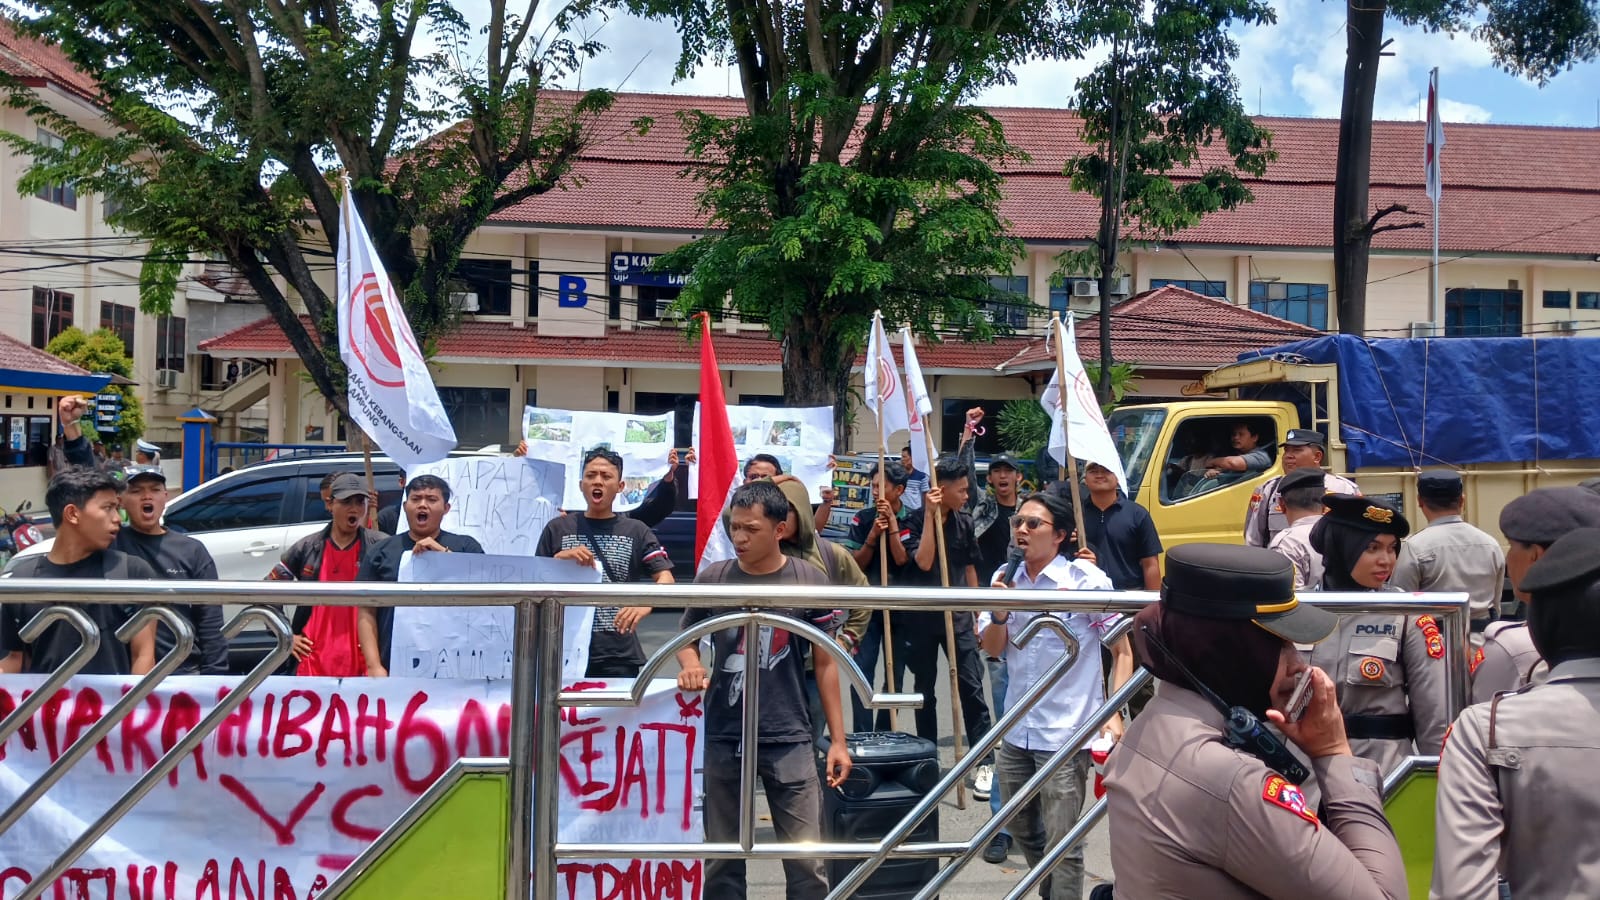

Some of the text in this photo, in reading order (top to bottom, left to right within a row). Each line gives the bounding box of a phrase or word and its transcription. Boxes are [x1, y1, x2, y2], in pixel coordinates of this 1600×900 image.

[559, 274, 589, 308] B
[368, 398, 423, 456] KEBANGSAAN
[456, 460, 510, 493] APA
[1355, 623, 1397, 636] POLRI
[216, 685, 395, 768] HIBAH
